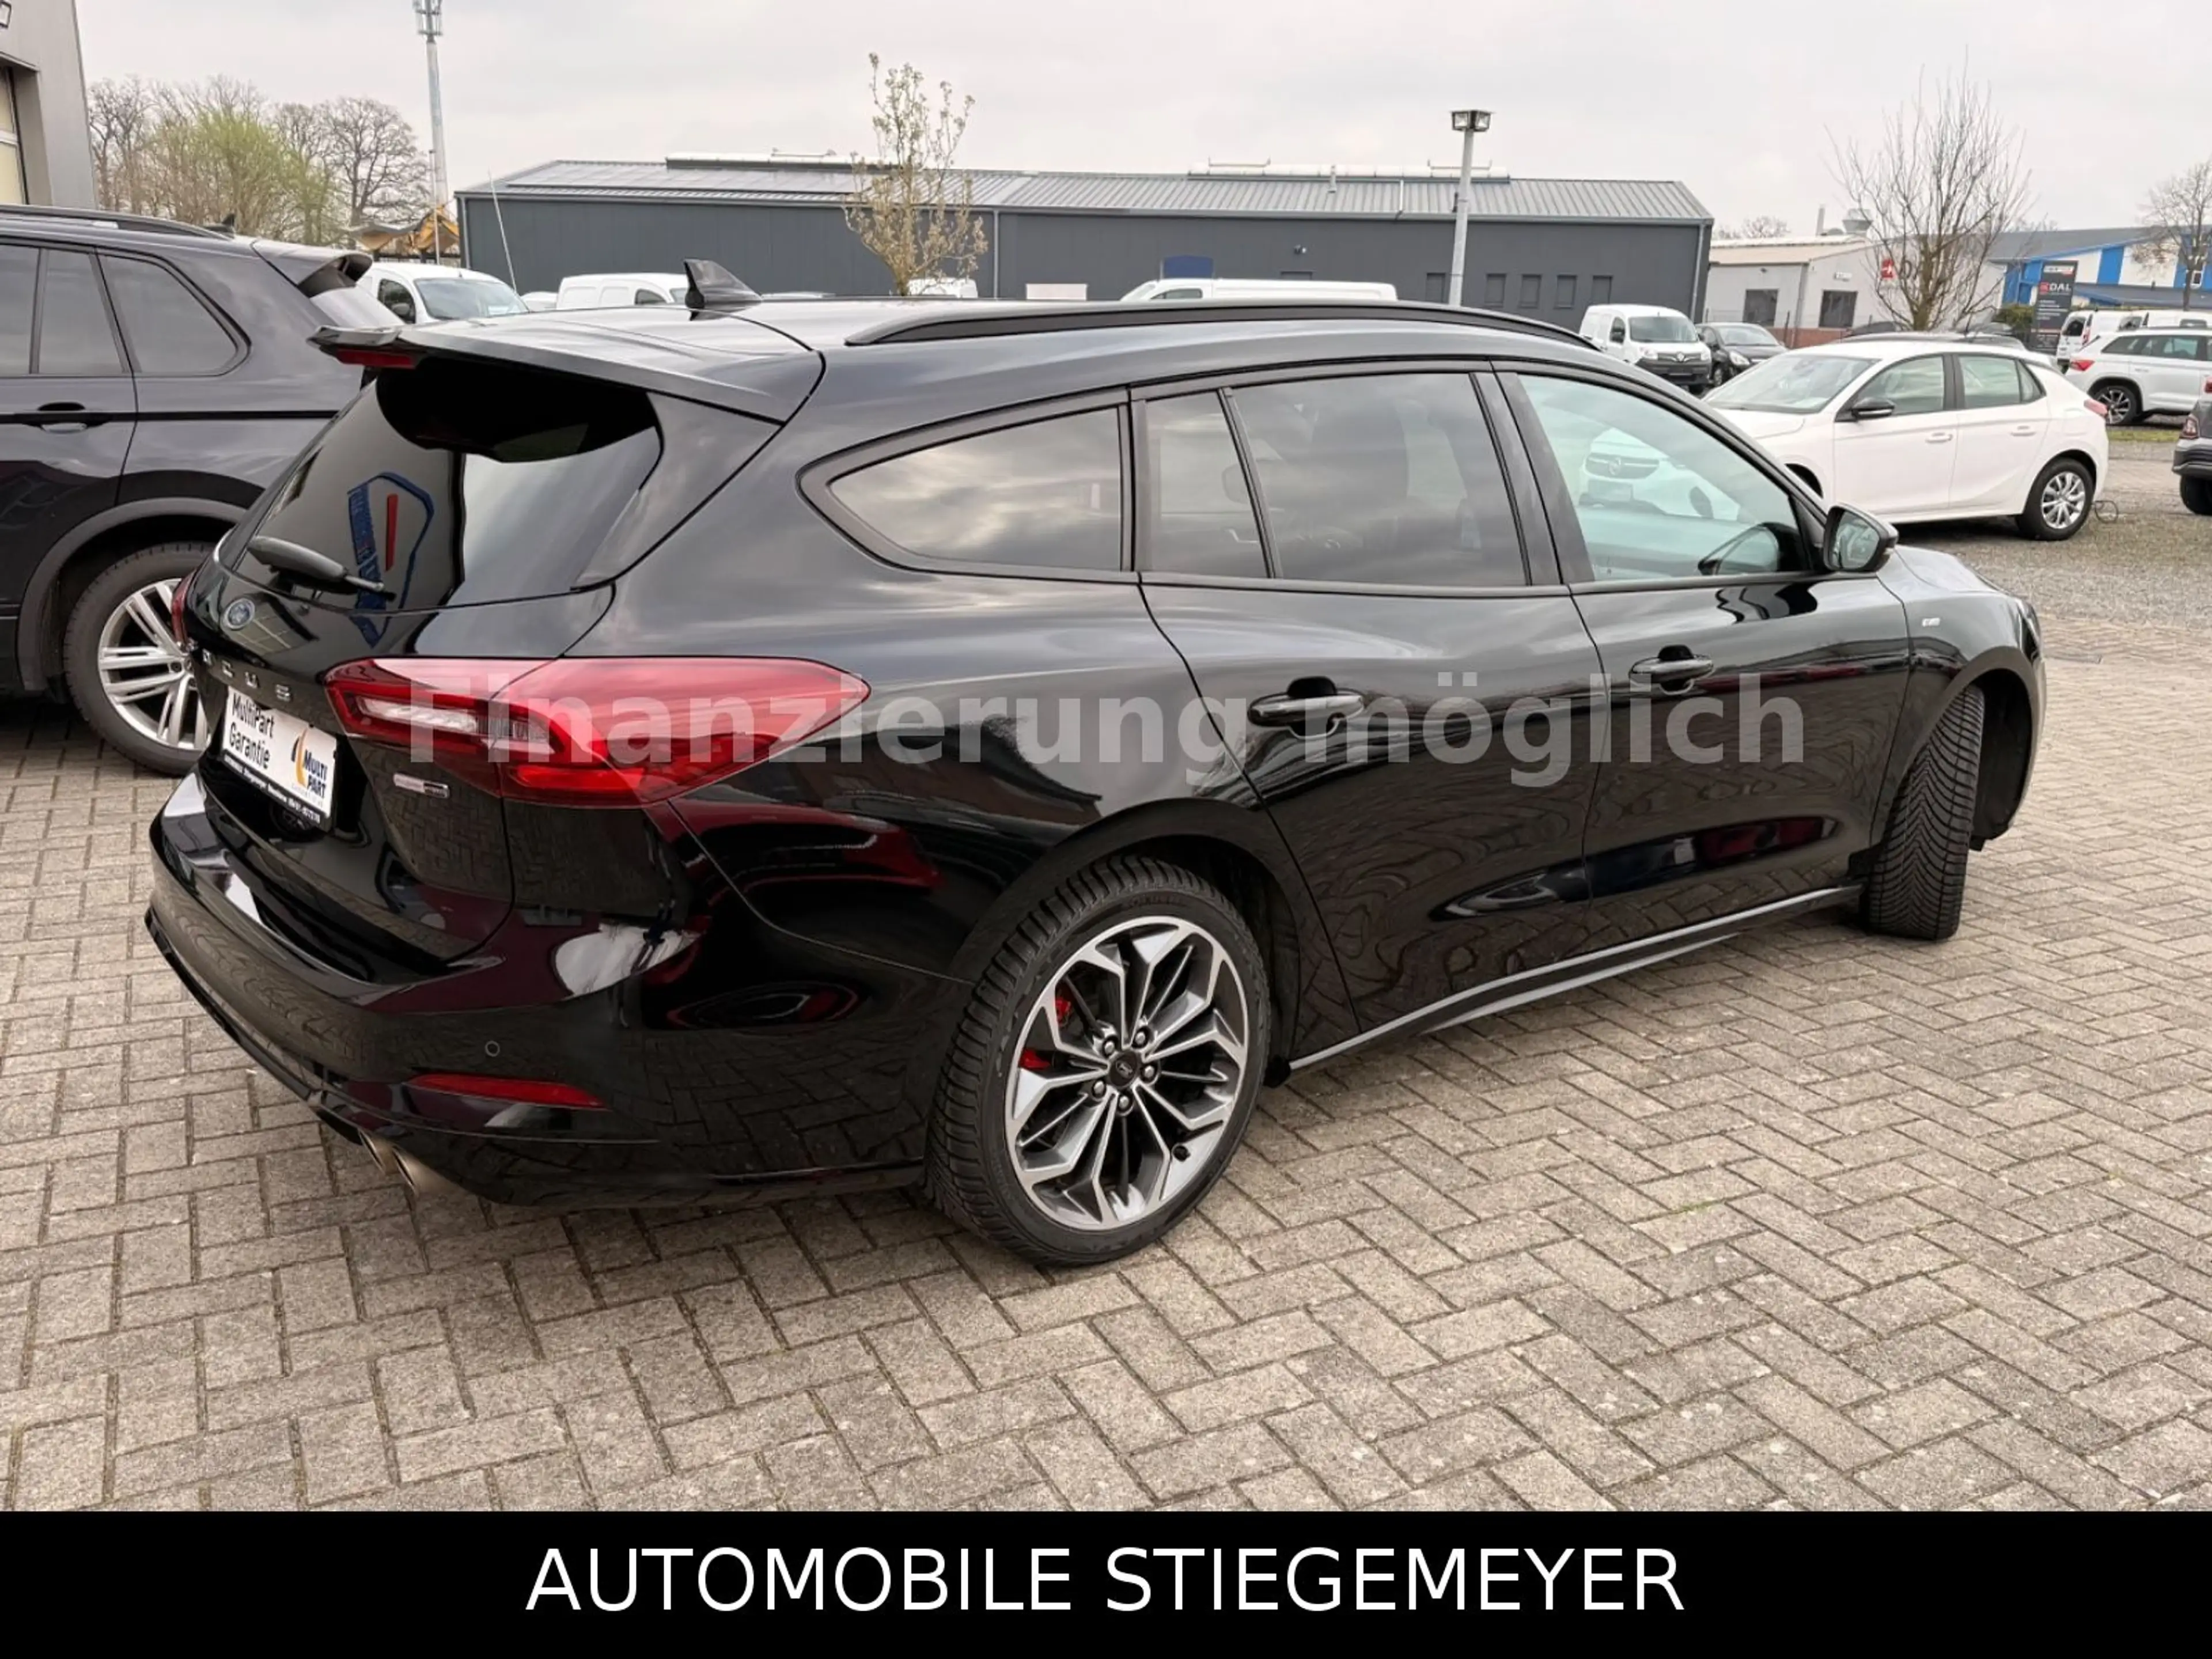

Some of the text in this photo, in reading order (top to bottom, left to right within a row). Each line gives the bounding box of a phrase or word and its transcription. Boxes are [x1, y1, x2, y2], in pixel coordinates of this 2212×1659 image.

[232, 692, 275, 738] MultiPart
[229, 722, 270, 770] Garantie
[306, 774, 326, 800] PART
